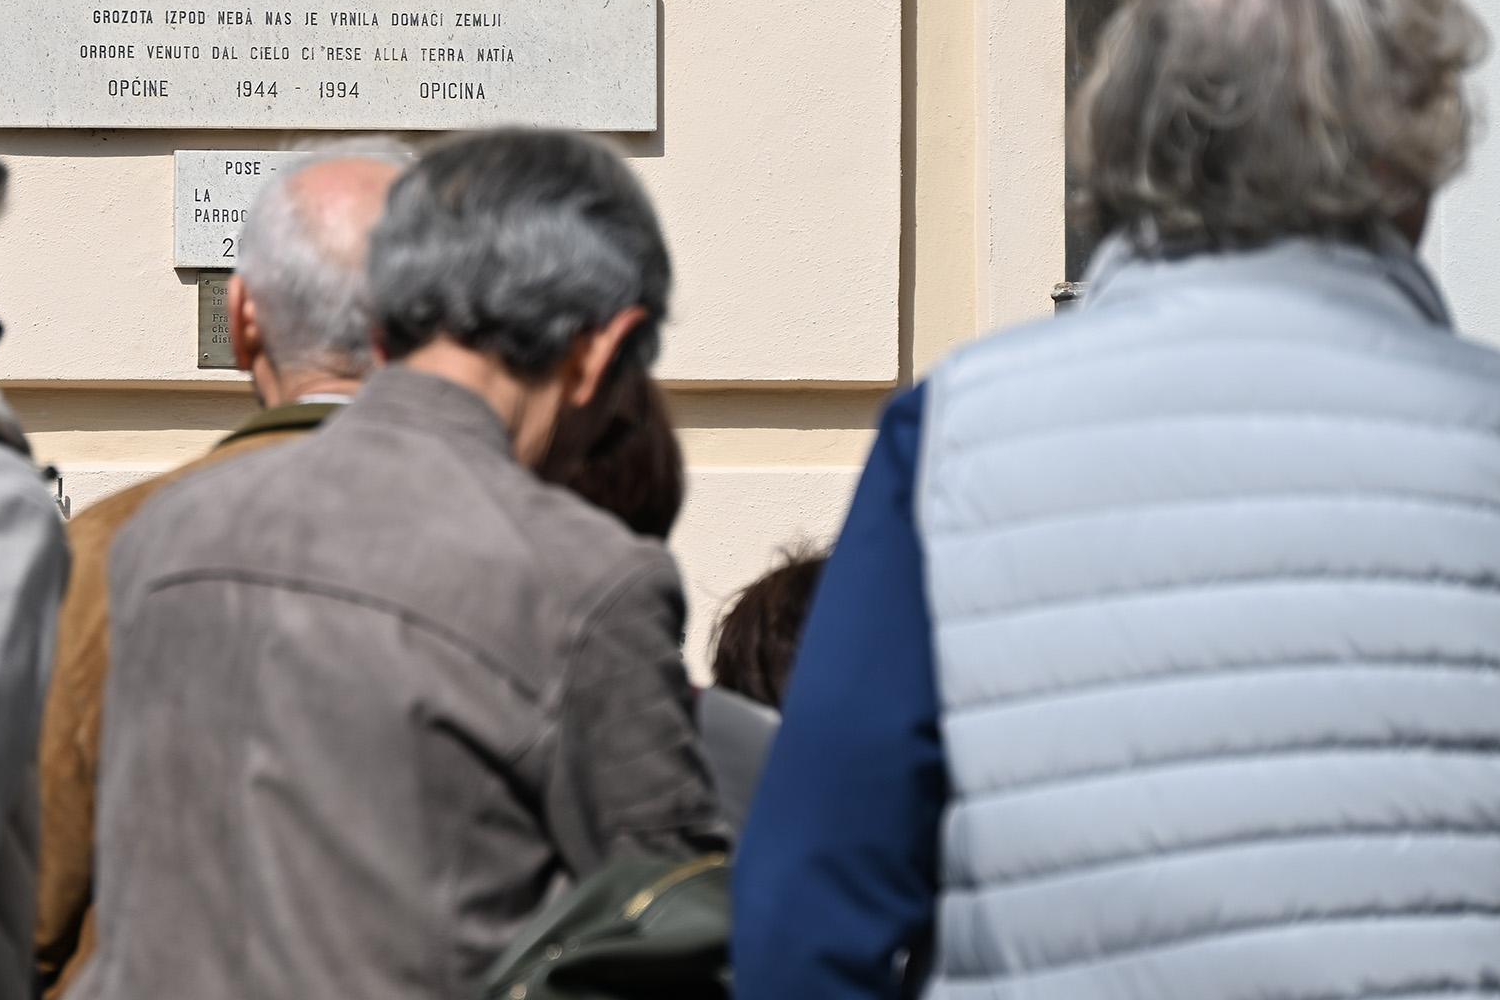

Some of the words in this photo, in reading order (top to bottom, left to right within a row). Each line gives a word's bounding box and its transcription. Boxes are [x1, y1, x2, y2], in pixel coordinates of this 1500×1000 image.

[93, 10, 153, 24] GROZOTA
[166, 11, 205, 24] IZPOD
[266, 12, 291, 25] NAS
[305, 12, 317, 25] JE
[331, 12, 378, 26] VRNILA
[456, 14, 500, 27] ZEMLJI
[80, 45, 134, 58] ORRORE
[147, 46, 199, 59] VENUTO
[213, 46, 238, 59] DAL
[251, 47, 289, 60] CIELO
[302, 47, 314, 60] CI
[375, 48, 407, 61] ALLA
[421, 48, 464, 61] TERRA
[237, 81, 278, 97] 1944
[319, 82, 359, 98] 1994
[420, 83, 485, 99] OPICINA
[226, 161, 260, 175] POSE
[195, 188, 210, 202] LA
